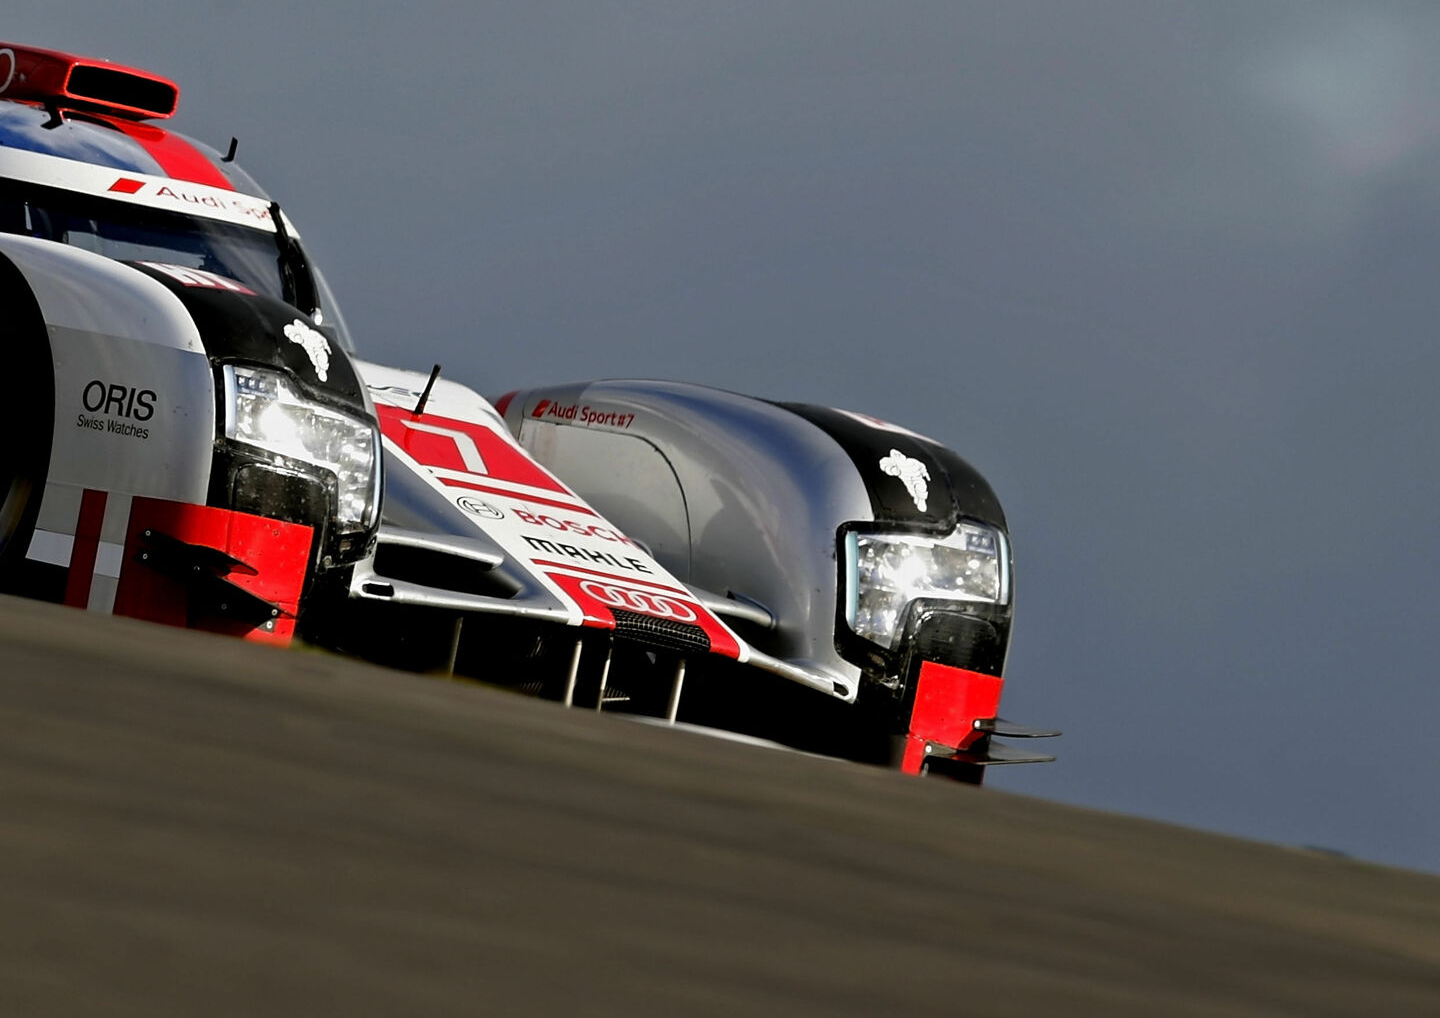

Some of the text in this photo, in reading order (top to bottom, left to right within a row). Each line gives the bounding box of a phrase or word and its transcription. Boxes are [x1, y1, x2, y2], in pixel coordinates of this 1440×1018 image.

[156, 185, 226, 210] Audi
[82, 379, 157, 422] ORIS
[547, 402, 579, 420] Audi
[76, 413, 149, 439] Swiss Watches
[511, 508, 633, 548] BOSCH
[520, 535, 654, 575] MAHLE
